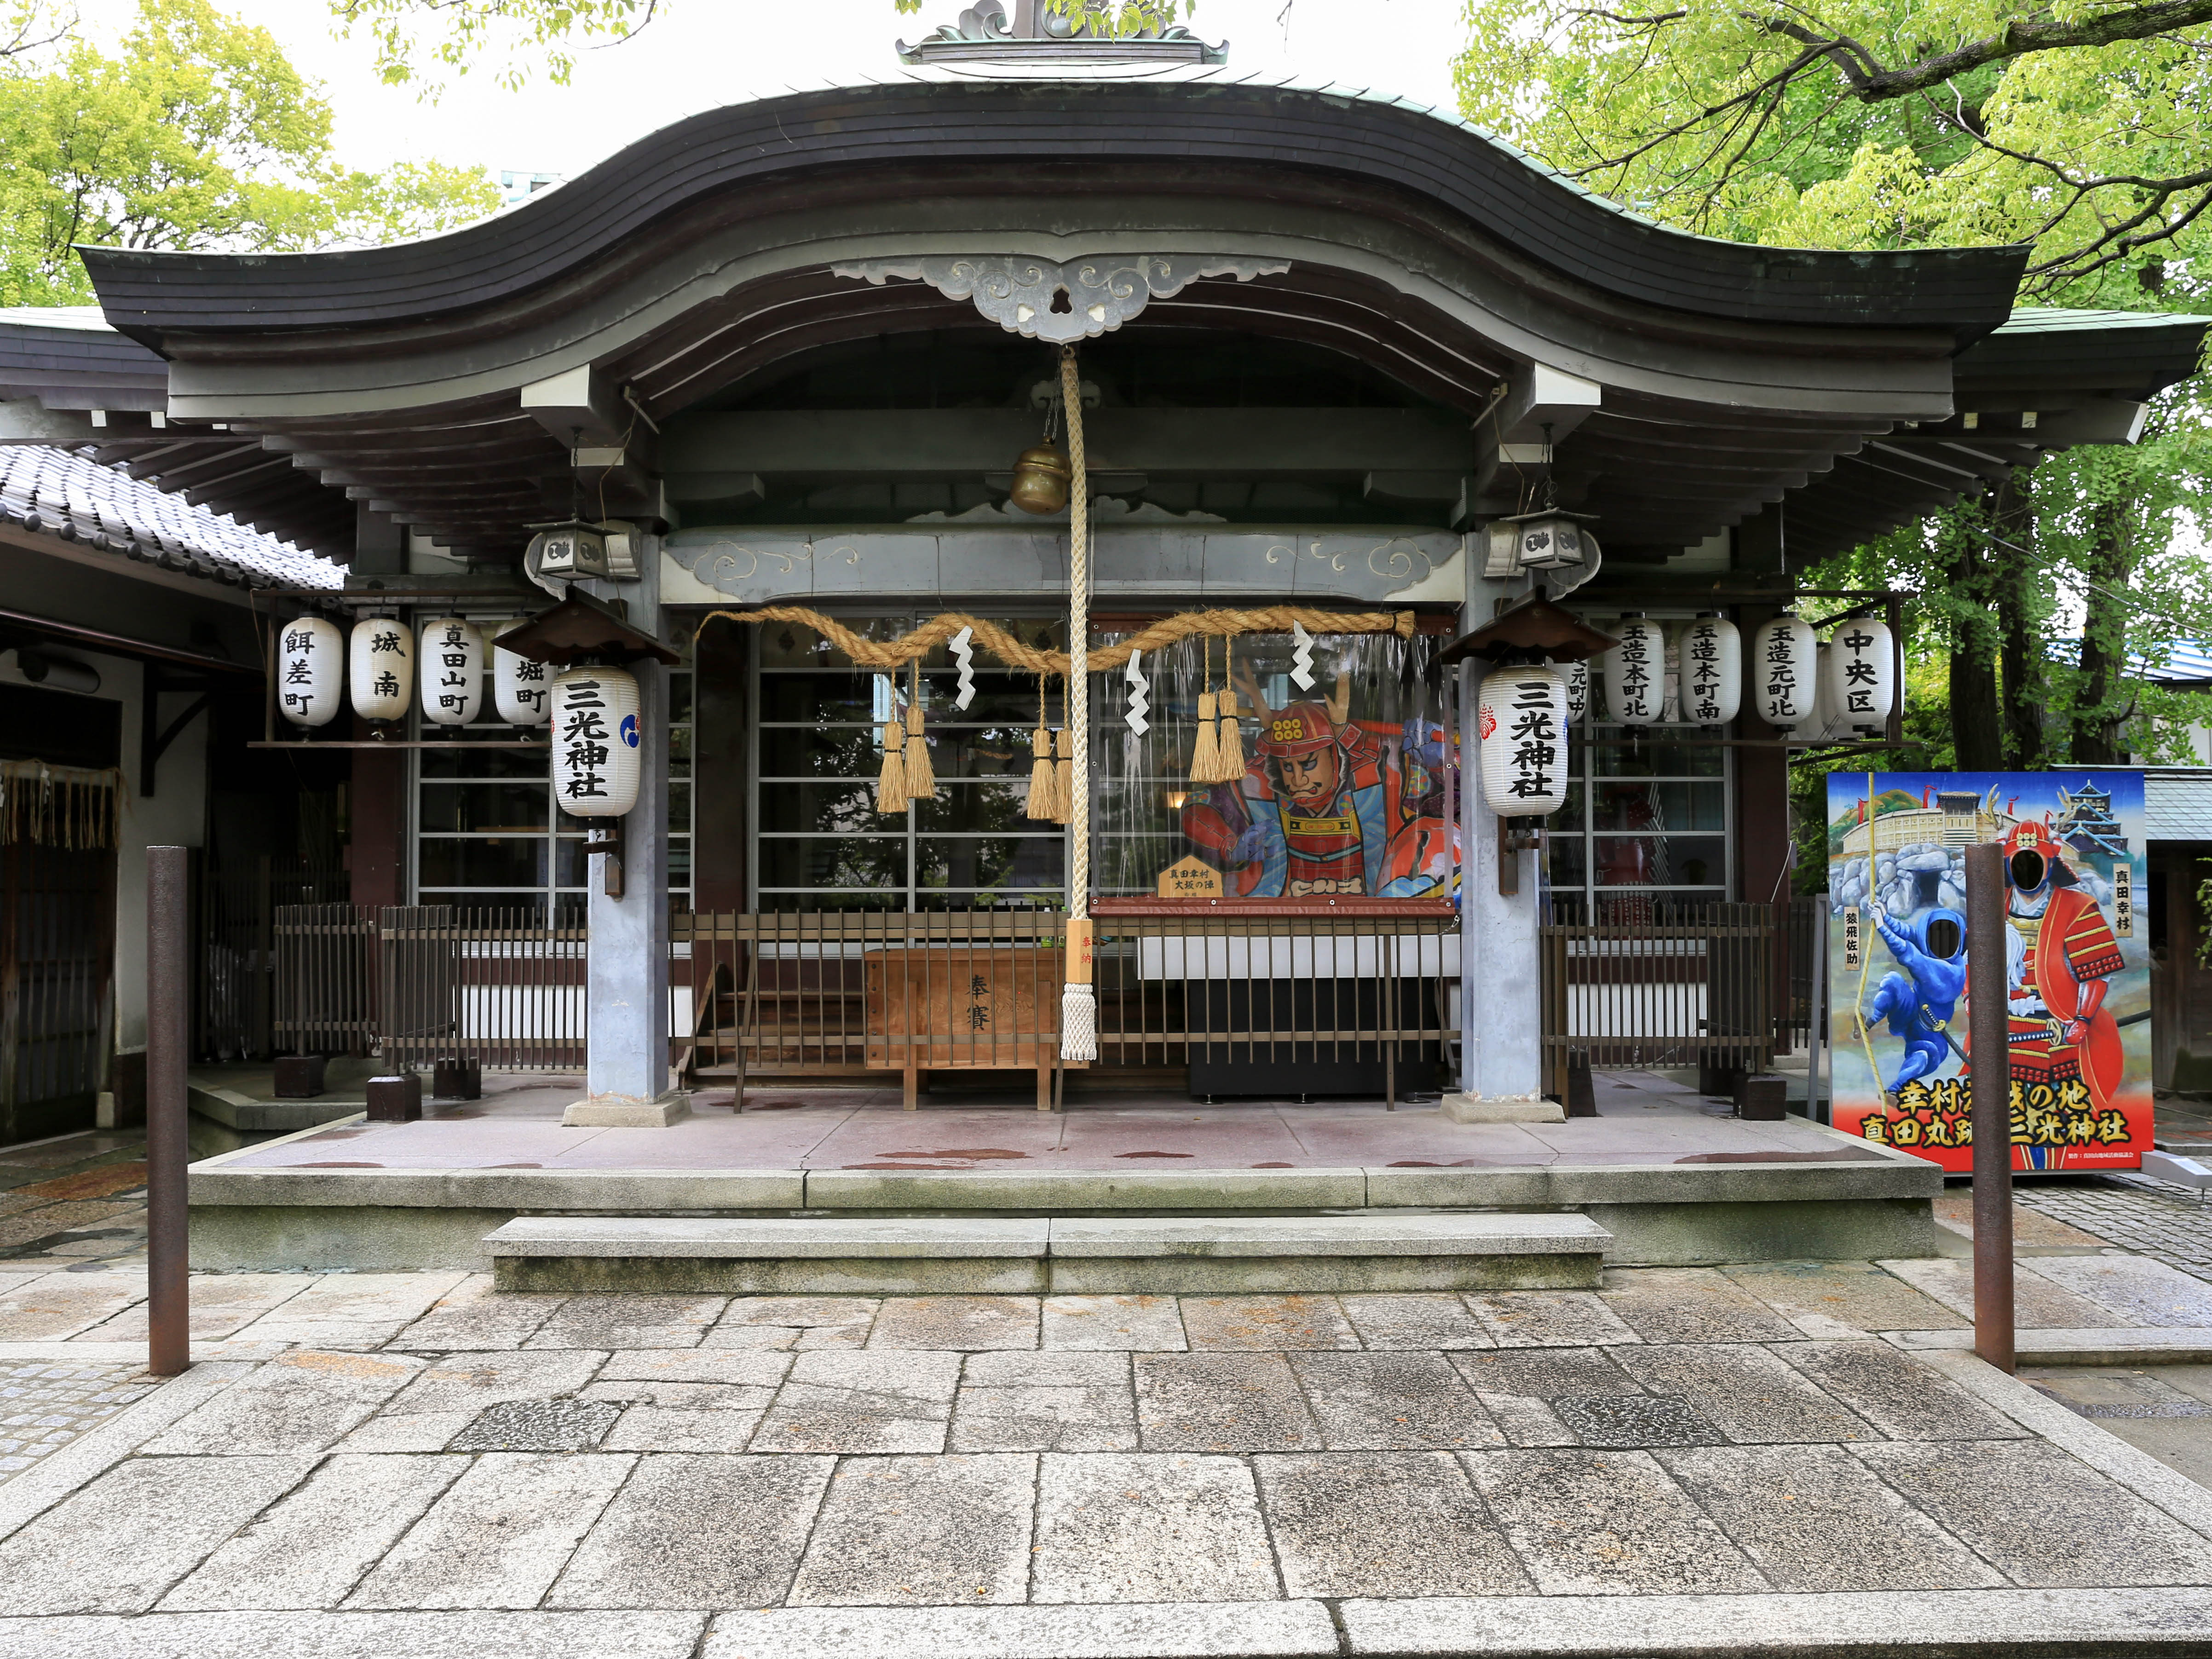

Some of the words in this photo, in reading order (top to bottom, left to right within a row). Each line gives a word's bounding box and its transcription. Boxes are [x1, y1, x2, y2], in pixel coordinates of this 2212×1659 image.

[284, 629, 316, 716] 餌差町
[371, 631, 406, 697] 城南
[439, 624, 470, 716] 真田山町
[515, 659, 547, 714] 堀町
[1567, 658, 1587, 716] 元町中
[1621, 624, 1651, 717] 玉造本町北
[1691, 624, 1721, 720] 玉造本町南
[1767, 626, 1797, 718] 玉造元町北
[1843, 628, 1879, 713] 中央区
[563, 680, 610, 799] 三光神社
[1508, 682, 1556, 799] 三光神社
[1169, 869, 1210, 879] 真田幸村
[1175, 880, 1215, 890] 大坂の陣
[2116, 870, 2130, 930] 真田幸村
[1081, 936, 1092, 964] 奉納
[1846, 912, 1858, 964] 猿飛佐助
[1898, 1079, 2090, 1115] 幸村の地
